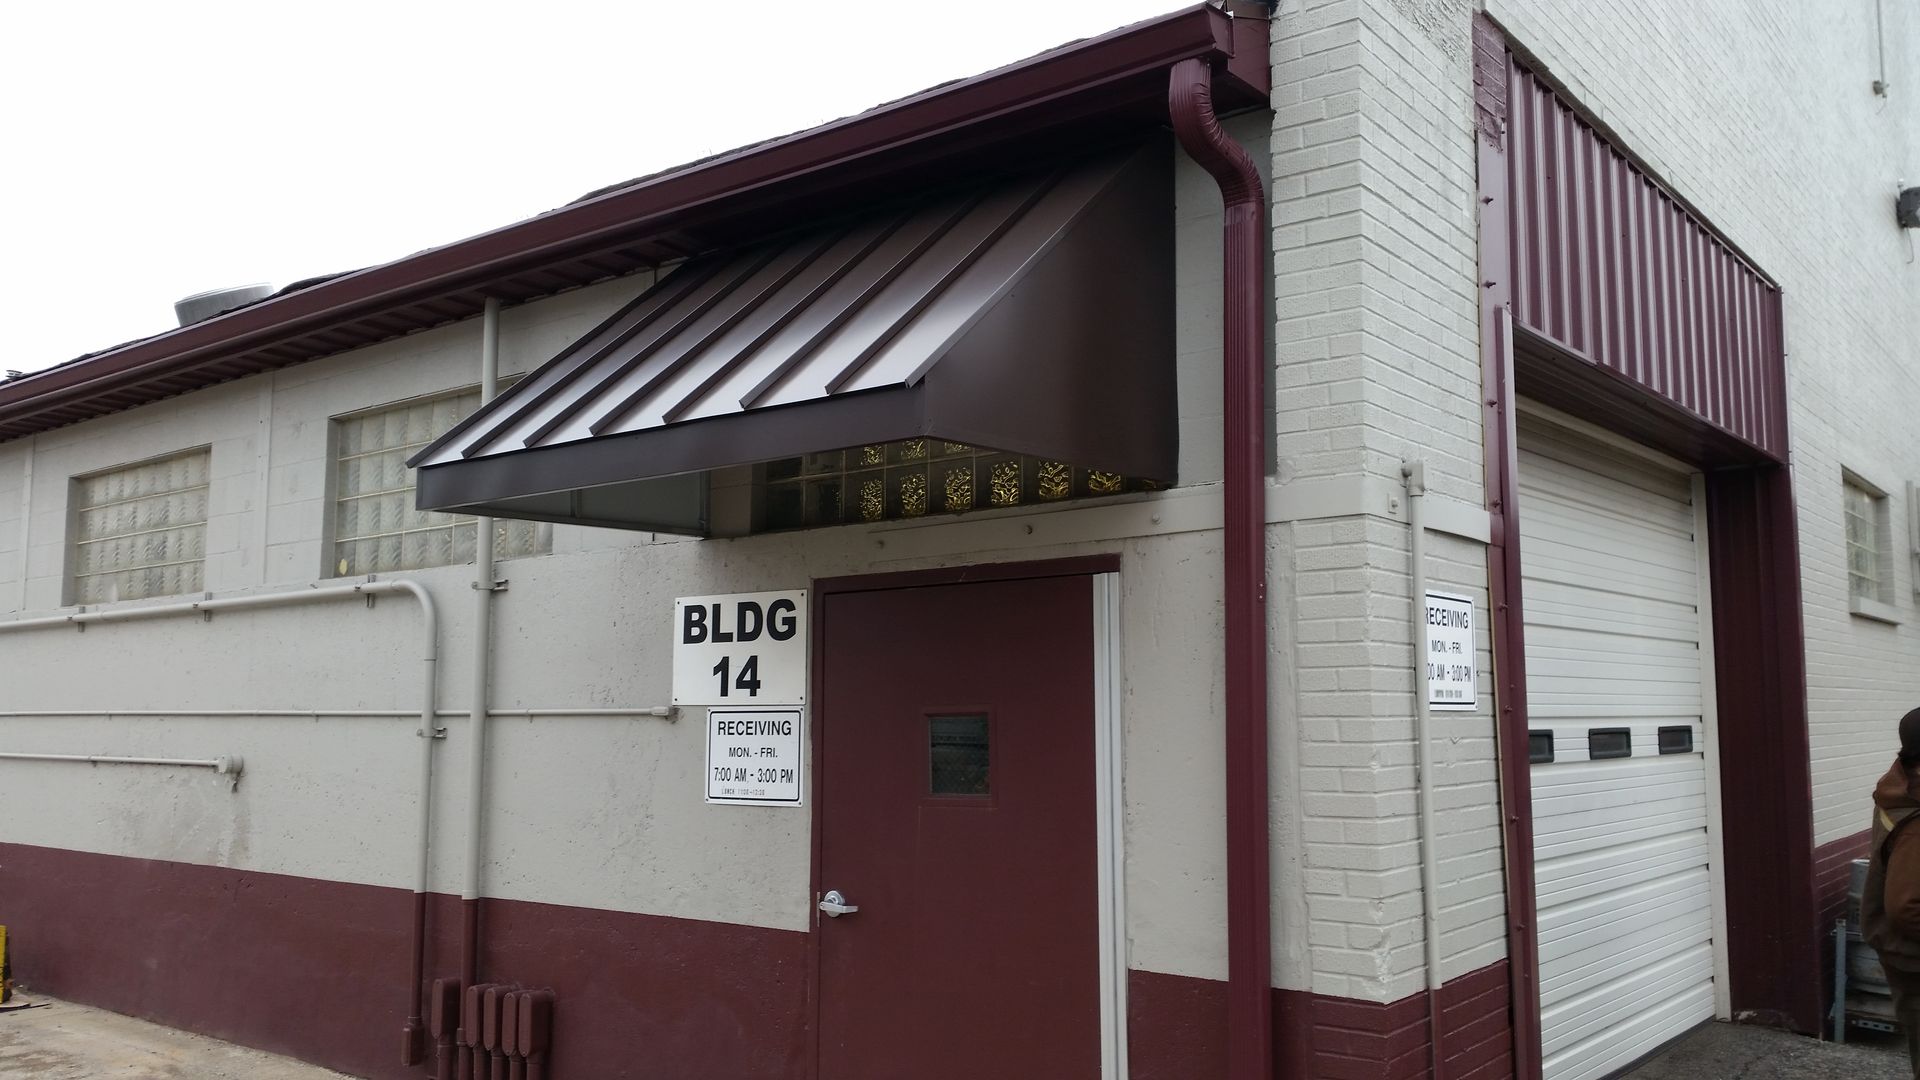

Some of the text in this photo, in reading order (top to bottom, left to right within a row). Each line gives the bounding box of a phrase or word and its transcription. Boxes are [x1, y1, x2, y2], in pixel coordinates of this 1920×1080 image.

[683, 598, 796, 644] BLDG
[1432, 640, 1447, 652] MON.
[1452, 642, 1462, 654] FRI.
[713, 655, 761, 697] 14
[1437, 664, 1445, 680] AM
[1452, 665, 1463, 682] 3:00
[1464, 666, 1471, 682] PM
[718, 721, 791, 736] RECEIVING
[729, 747, 752, 758] MON.
[760, 747, 778, 758] FRI.
[714, 767, 731, 782] 7:00
[758, 769, 777, 783] 3:00
[780, 769, 793, 783] PM
